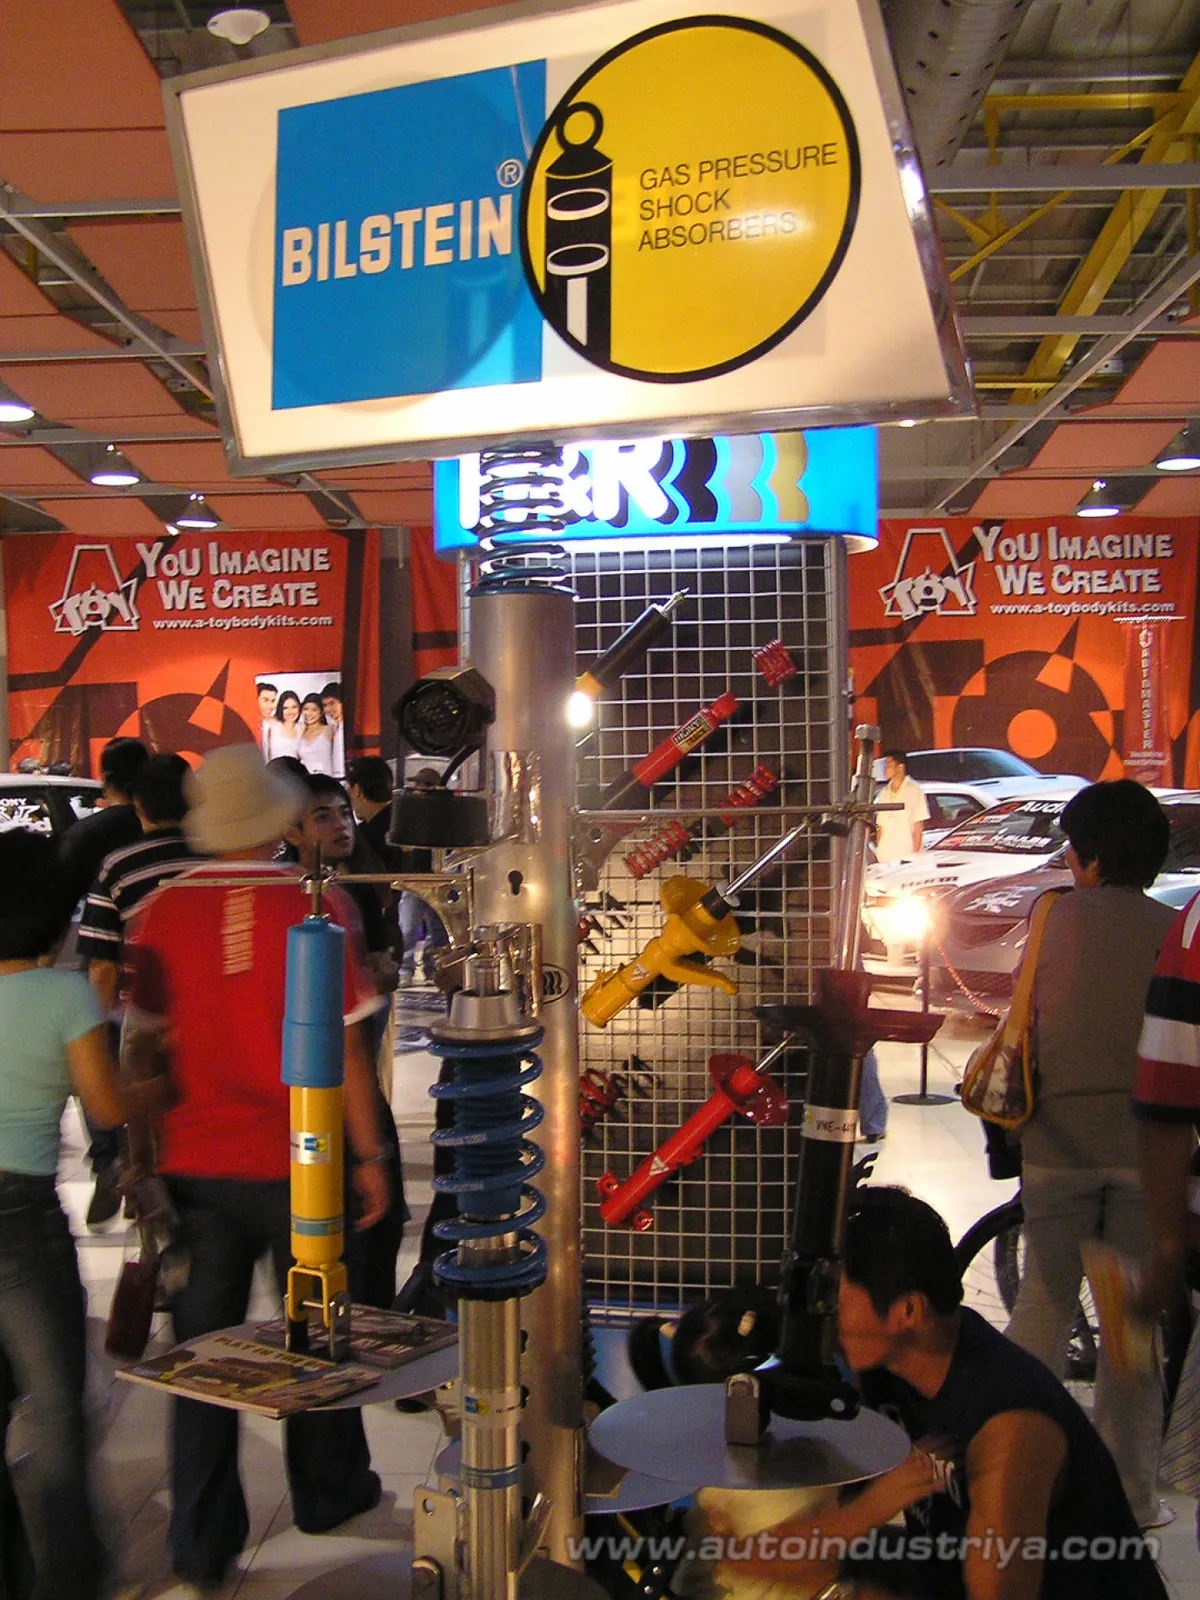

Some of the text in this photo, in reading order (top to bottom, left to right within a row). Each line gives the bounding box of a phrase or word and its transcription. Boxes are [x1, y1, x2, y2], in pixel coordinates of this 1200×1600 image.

[640, 142, 838, 191] GAS PRESSURE
[640, 189, 731, 221] SHOCK
[281, 194, 513, 287] BILSTEIN
[638, 212, 797, 252] ABSORBERS
[153, 614, 333, 630] www.a-toybodykits.com
[990, 601, 1176, 616] www.a-toybodykits.com
